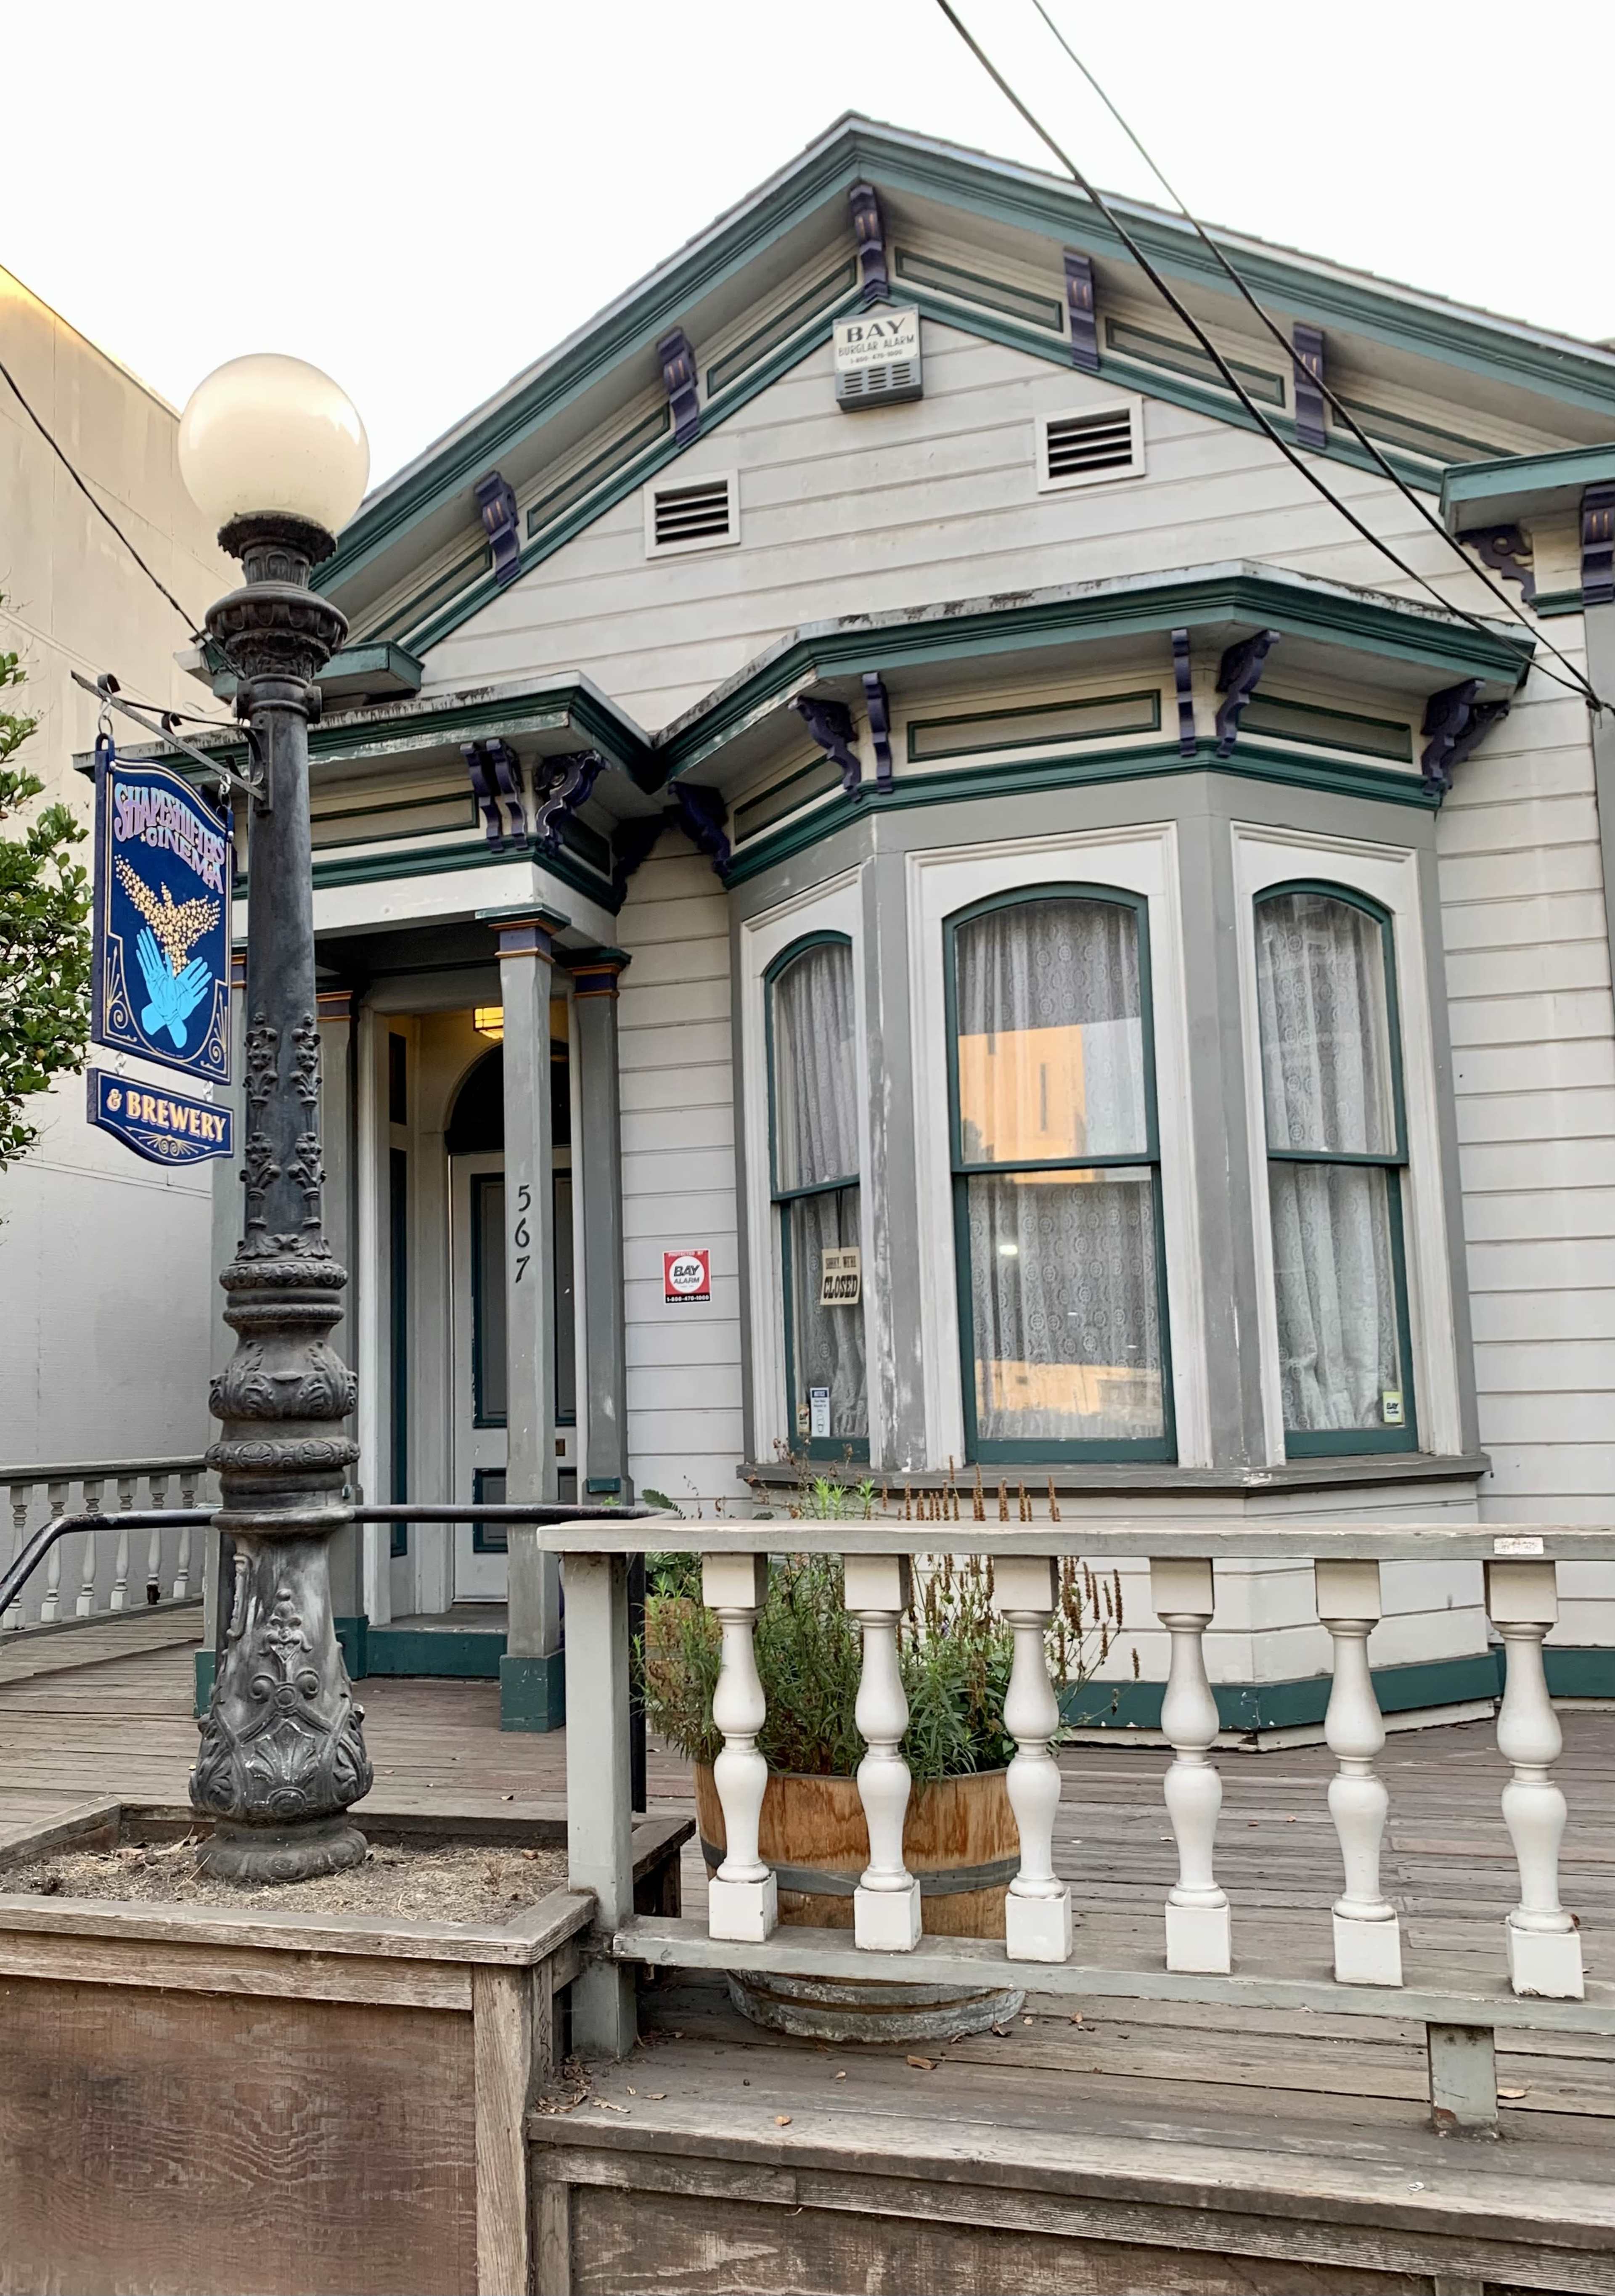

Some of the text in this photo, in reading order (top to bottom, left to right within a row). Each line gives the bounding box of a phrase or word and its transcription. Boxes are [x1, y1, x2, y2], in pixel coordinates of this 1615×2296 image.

[847, 317, 905, 343] BAY
[838, 334, 914, 357] BURGLAR ALARM
[114, 782, 225, 865] SHAPESHIFTERS
[145, 826, 224, 894] CINEMA
[106, 1088, 227, 1143] & BREWERY
[674, 1264, 700, 1277] BAY
[823, 1274, 858, 1299] CLOSED
